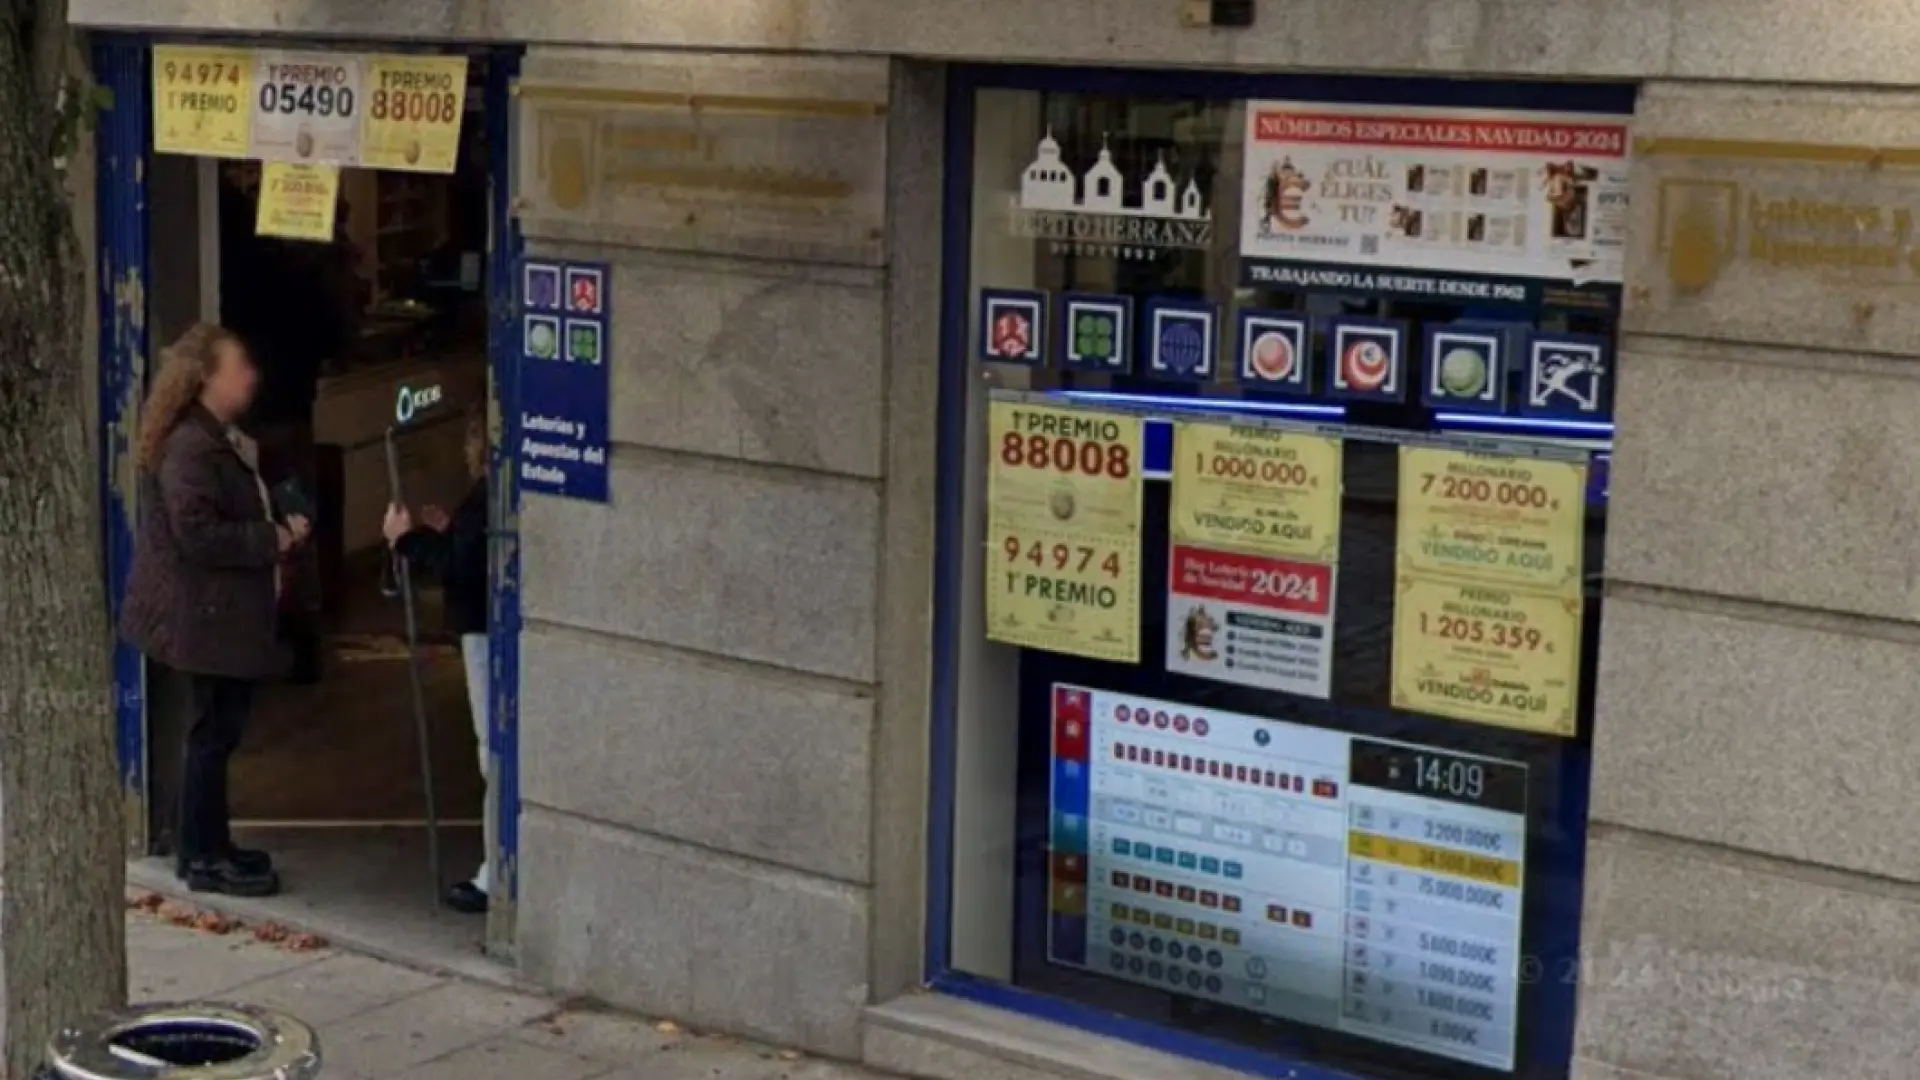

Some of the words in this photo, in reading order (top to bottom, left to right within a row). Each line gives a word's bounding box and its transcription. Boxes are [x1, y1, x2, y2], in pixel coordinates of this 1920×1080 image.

[164, 61, 241, 87] 94974
[281, 64, 347, 84] PREMIO
[391, 71, 453, 91] PREMIO
[180, 92, 238, 114] PREMIO
[259, 82, 353, 117] 05490
[371, 89, 457, 124] 88008
[1355, 120, 1472, 143] ESPECIALES
[1474, 125, 1572, 148] NAVIDAD
[1250, 265, 1352, 287] TRABAJANDO
[1353, 272, 1375, 290] LA
[1027, 413, 1119, 441] PREMIO
[1001, 430, 1130, 479] 88008
[1004, 535, 1121, 580] 94974
[1024, 573, 1118, 609] PREMIO
[1250, 567, 1319, 602] 2024
[1417, 679, 1494, 704] VENDIDO
[1414, 756, 1485, 799] 14:09
